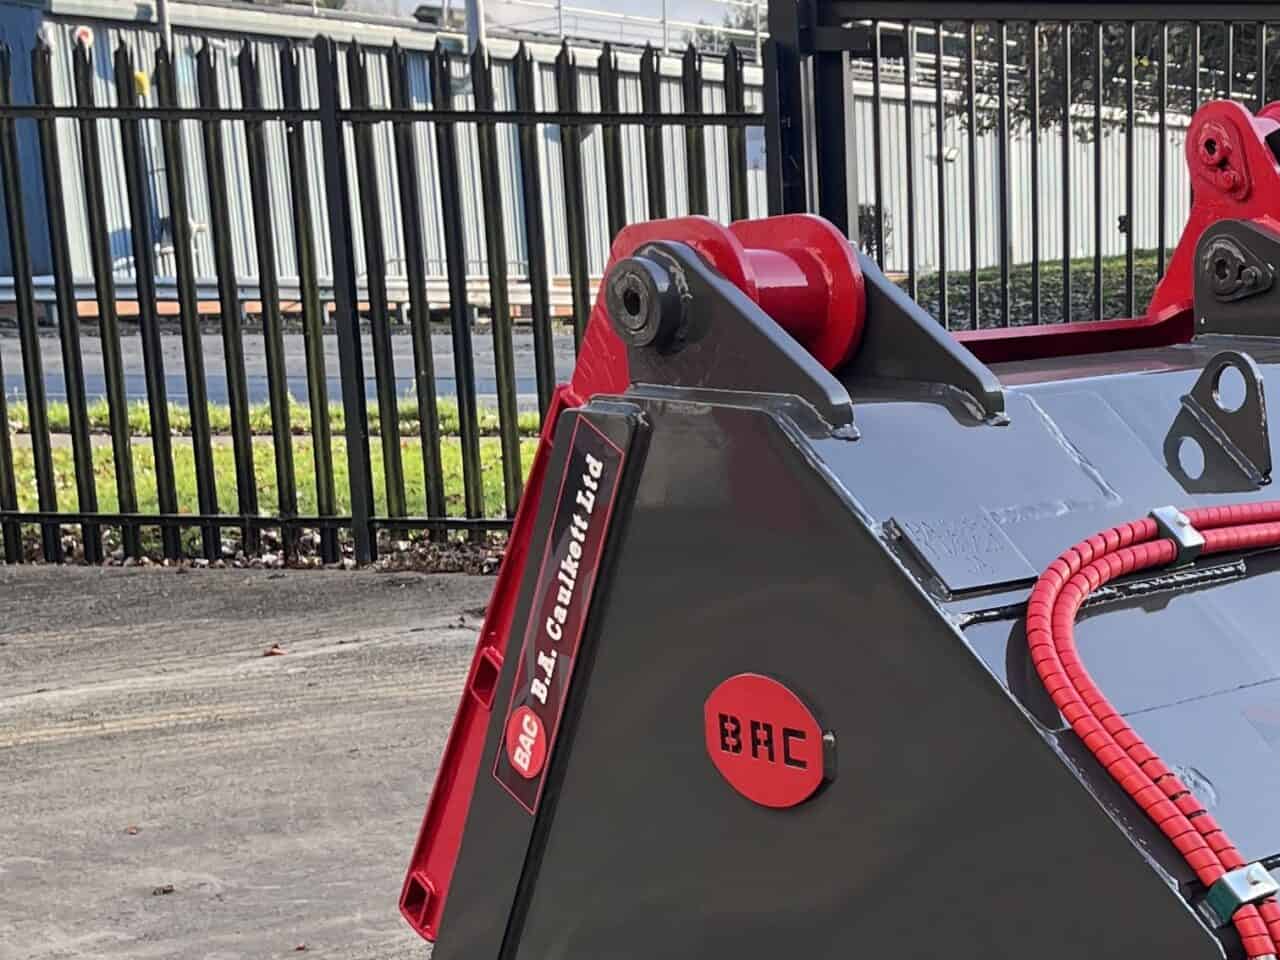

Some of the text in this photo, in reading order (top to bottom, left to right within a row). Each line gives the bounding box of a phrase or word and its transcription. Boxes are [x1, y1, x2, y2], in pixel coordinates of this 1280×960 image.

[531, 453, 603, 704] B.A. Caulkett Ltd
[514, 714, 539, 771] BAC
[718, 712, 807, 769] BAC
